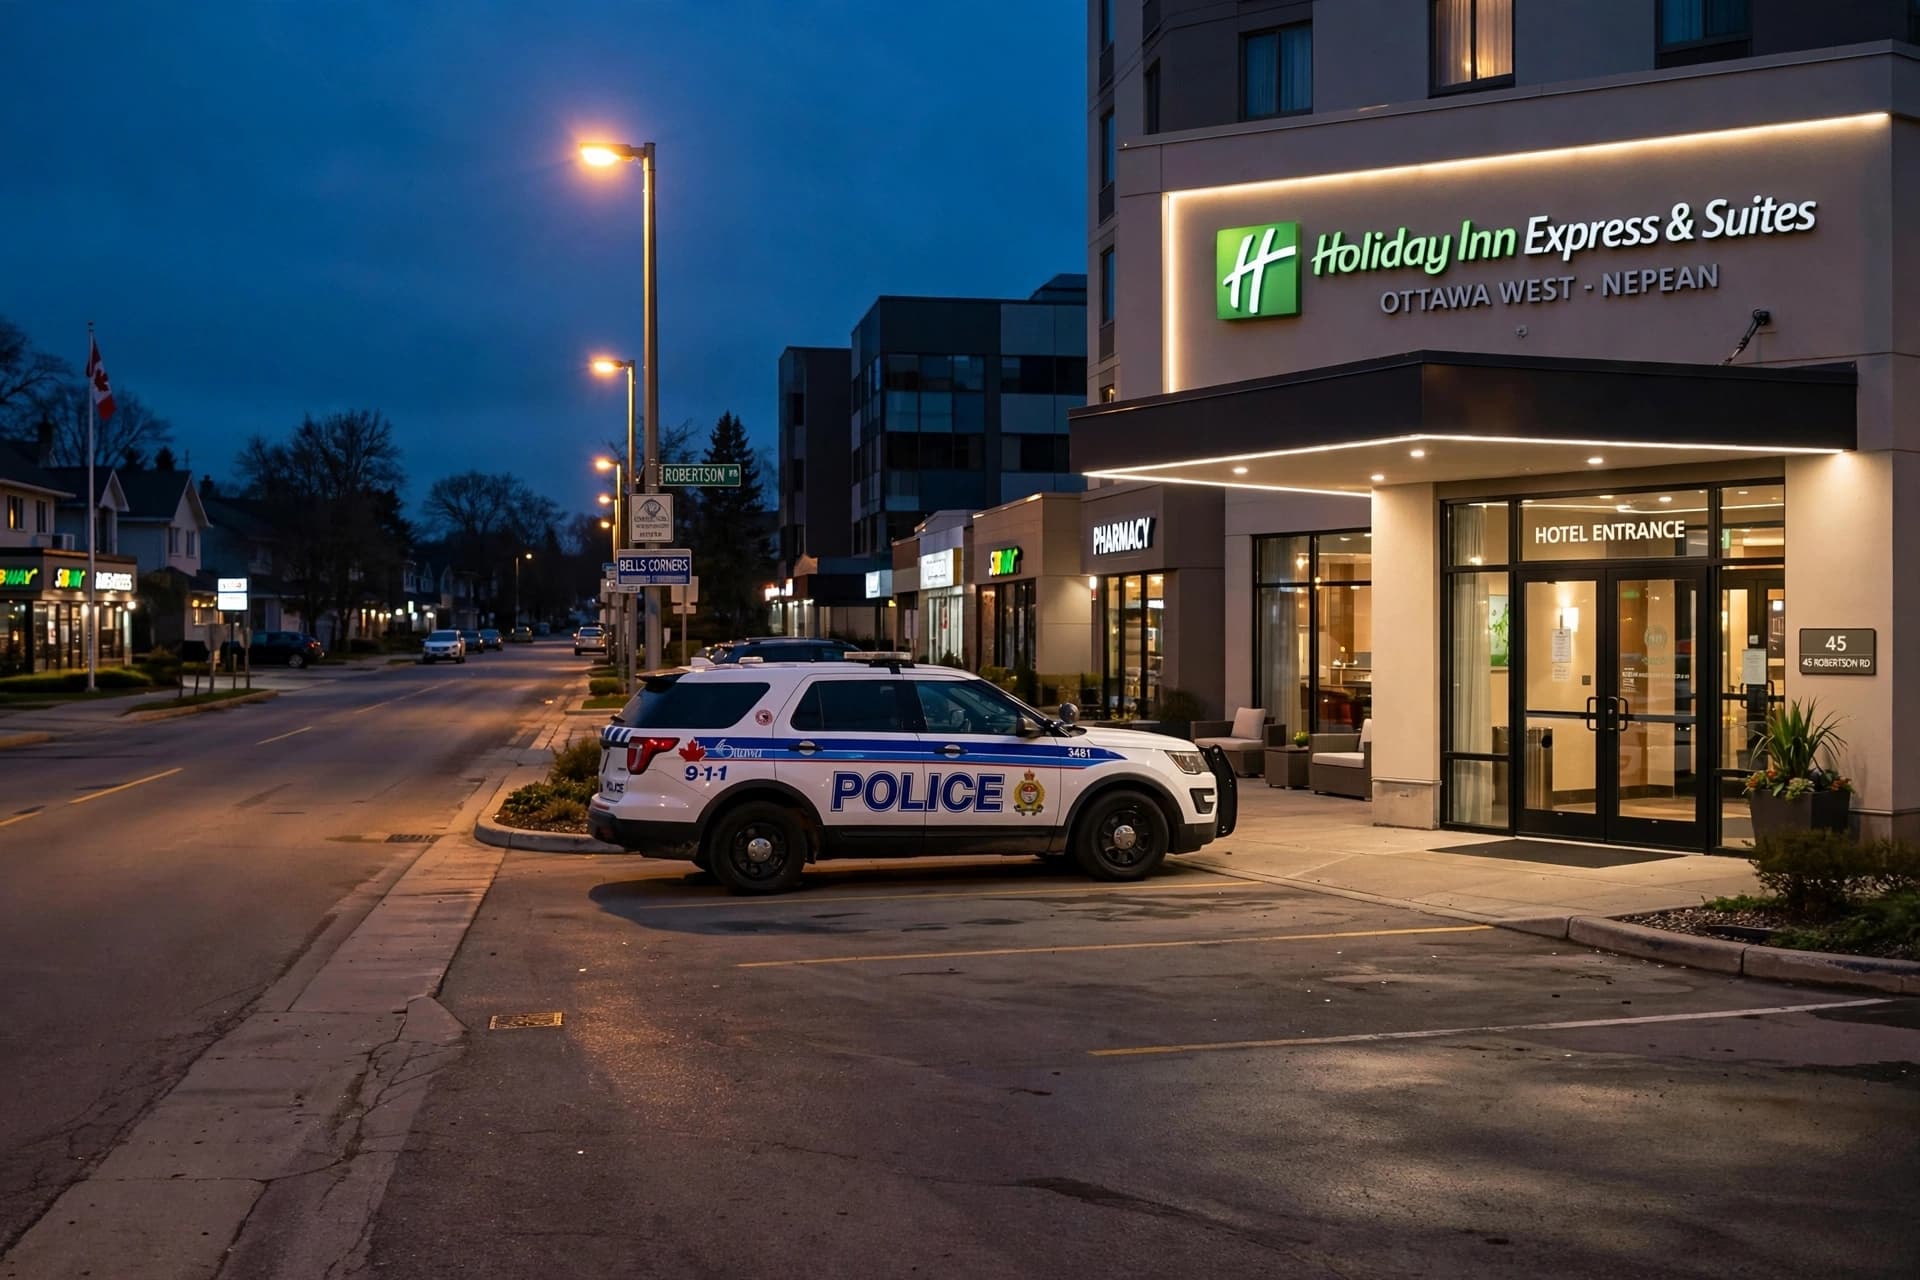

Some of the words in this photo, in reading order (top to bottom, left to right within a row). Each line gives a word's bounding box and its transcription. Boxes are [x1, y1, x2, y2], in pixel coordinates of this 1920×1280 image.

[1311, 226, 1451, 275] Holiday
[1458, 219, 1516, 261] Inn
[1524, 214, 1660, 262] Express
[1665, 202, 1694, 242] &
[1701, 195, 1817, 239] Suites
[1380, 282, 1491, 314] OTTAWA
[1499, 275, 1576, 304] WEST
[1602, 263, 1719, 297] NEPEAN
[665, 467, 725, 482] ROBERTSON
[1093, 517, 1150, 555] PHARMACY
[1535, 525, 1588, 544] HOTEL
[1593, 520, 1685, 541] ENTRANCE
[619, 559, 647, 572] BELLS
[648, 559, 689, 572] CORNERS
[1825, 635, 1847, 651] 45
[1802, 658, 1813, 667] 45
[1813, 658, 1858, 668] ROBERTSON
[1859, 658, 1871, 668] RD
[1067, 747, 1091, 758] 3481
[685, 765, 727, 781] 9-1-1
[830, 771, 1005, 812] POLICE
